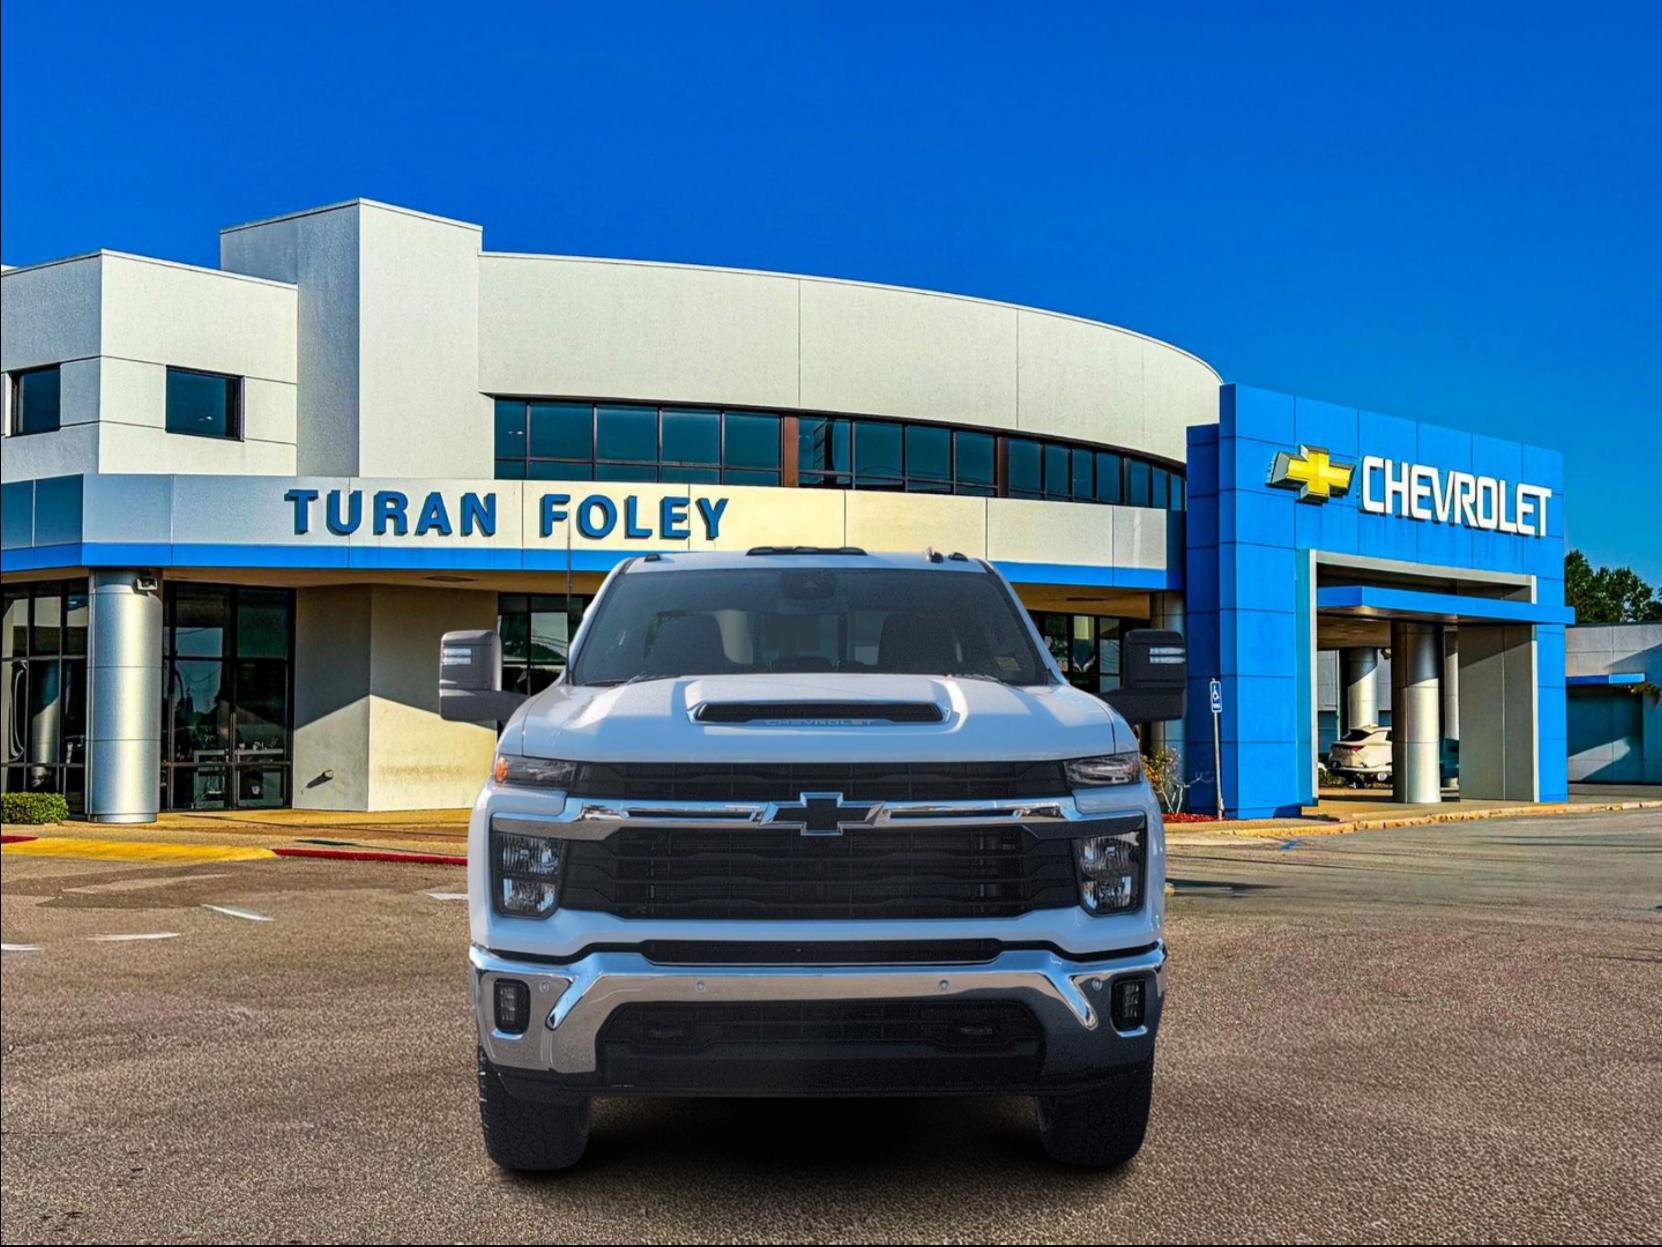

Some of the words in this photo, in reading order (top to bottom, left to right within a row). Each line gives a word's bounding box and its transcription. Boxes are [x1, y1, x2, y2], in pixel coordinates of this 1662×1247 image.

[284, 489, 496, 537] TURAN
[539, 494, 729, 541] FOLEY
[1361, 455, 1552, 537] CHEVROLET
